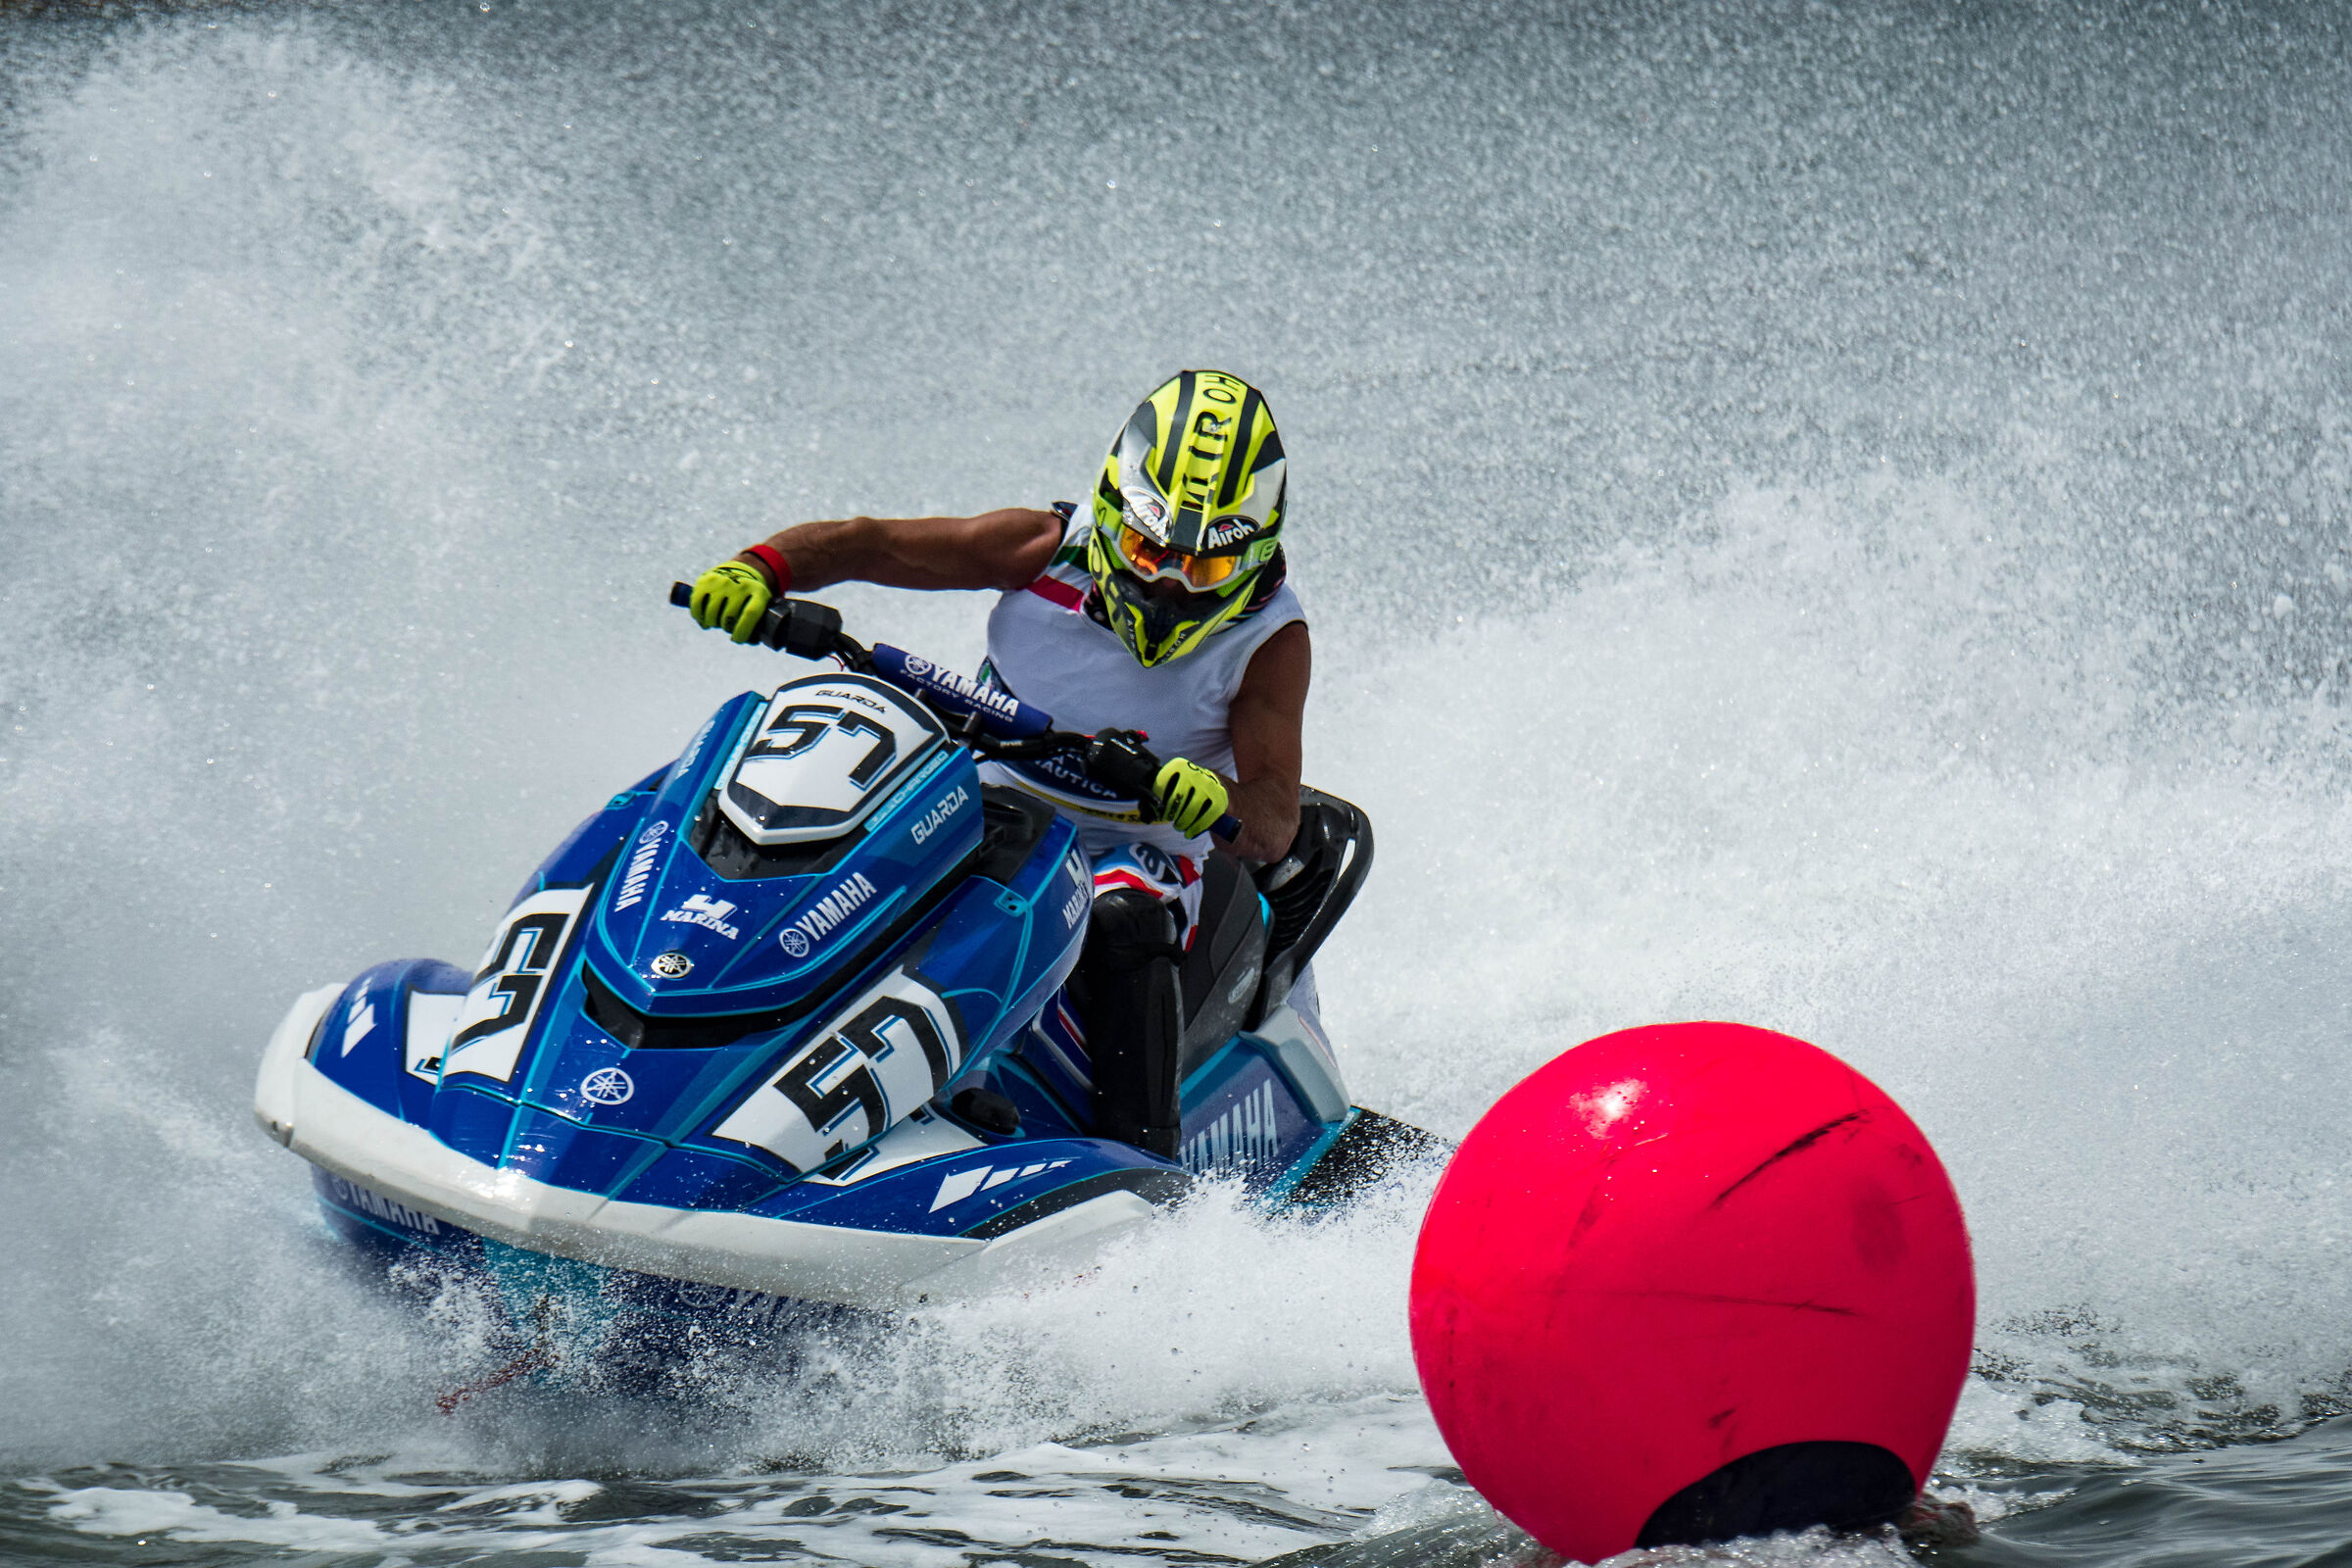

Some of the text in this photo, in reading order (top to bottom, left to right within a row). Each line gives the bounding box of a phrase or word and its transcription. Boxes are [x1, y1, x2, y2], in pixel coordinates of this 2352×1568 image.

[1207, 519, 1255, 550] Airoh
[814, 689, 887, 714] GUARDA
[900, 668, 1014, 723] FACTORY RACING
[932, 666, 1019, 716] YAMAHA
[745, 703, 899, 790] 57
[910, 785, 969, 845] GUARDA
[614, 838, 662, 912] YAMAHA
[660, 909, 740, 941] MARINA
[796, 871, 877, 941] YAMAHA
[772, 995, 954, 1181] 57
